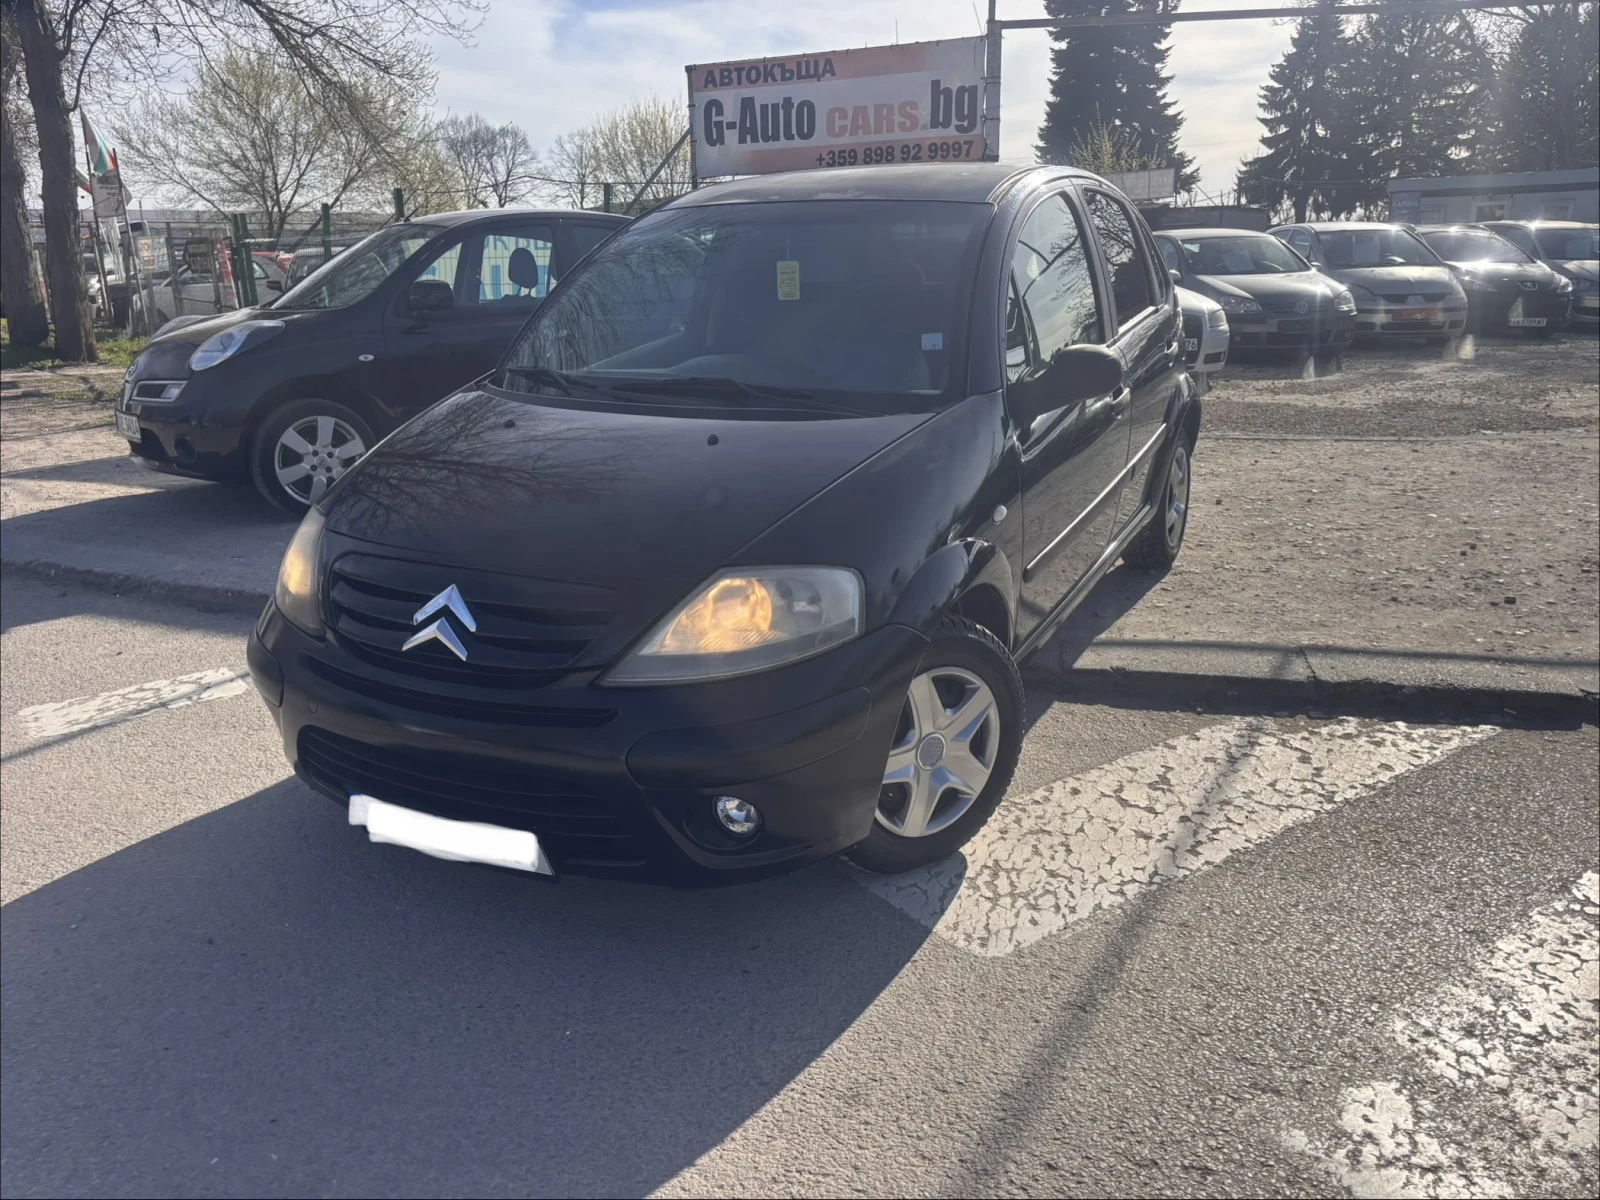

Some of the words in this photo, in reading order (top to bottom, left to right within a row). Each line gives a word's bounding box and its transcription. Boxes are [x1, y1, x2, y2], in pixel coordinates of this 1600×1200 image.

[703, 57, 837, 89] АВТОКЪЩА
[703, 95, 816, 148] G-Auto
[815, 149, 858, 168] +359
[863, 145, 896, 164] 898
[900, 143, 922, 161] 92
[928, 140, 974, 160] 9997
